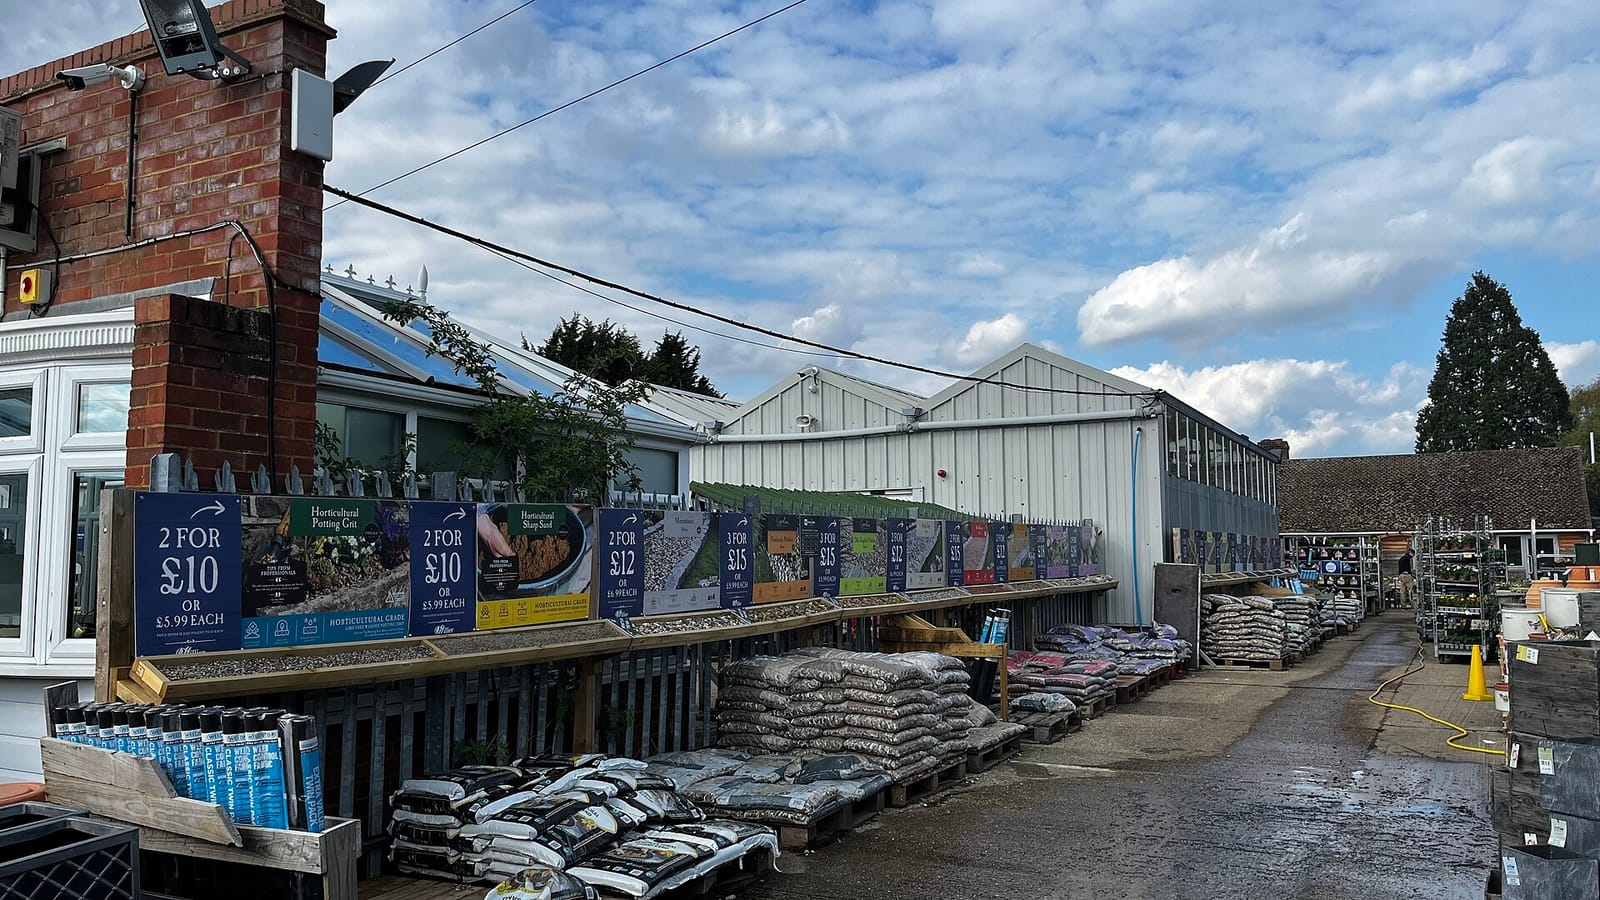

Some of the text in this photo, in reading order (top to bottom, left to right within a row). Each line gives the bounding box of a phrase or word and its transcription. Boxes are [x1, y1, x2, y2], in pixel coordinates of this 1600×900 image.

[311, 506, 359, 517] Horticultural
[521, 510, 555, 520] Horticultural
[312, 517, 357, 532] Potting Grit
[522, 520, 553, 531] Sharp Sand
[158, 527, 221, 548] 2 FOR
[423, 529, 462, 547] 2 FOR
[609, 531, 636, 546] 2 FOR
[726, 532, 748, 545] 3 FOR
[609, 550, 635, 576] £12
[727, 548, 747, 571] £15
[820, 547, 836, 566] £15
[160, 555, 219, 595] £10
[425, 552, 461, 584] £10
[618, 579, 627, 588] OR
[438, 587, 451, 597] OR
[607, 588, 638, 598] £6.99 EACH
[182, 599, 201, 612] OR
[422, 598, 465, 611] £5.99 EACH
[156, 612, 224, 629] £5.99 EACH
[329, 613, 405, 627] HORTICULTURAL GRADE
[205, 747, 215, 783] CLASSIC
[225, 748, 233, 785] CLASSIC
[313, 766, 321, 797] EXTRA
[305, 774, 318, 827] TWIN PACK
